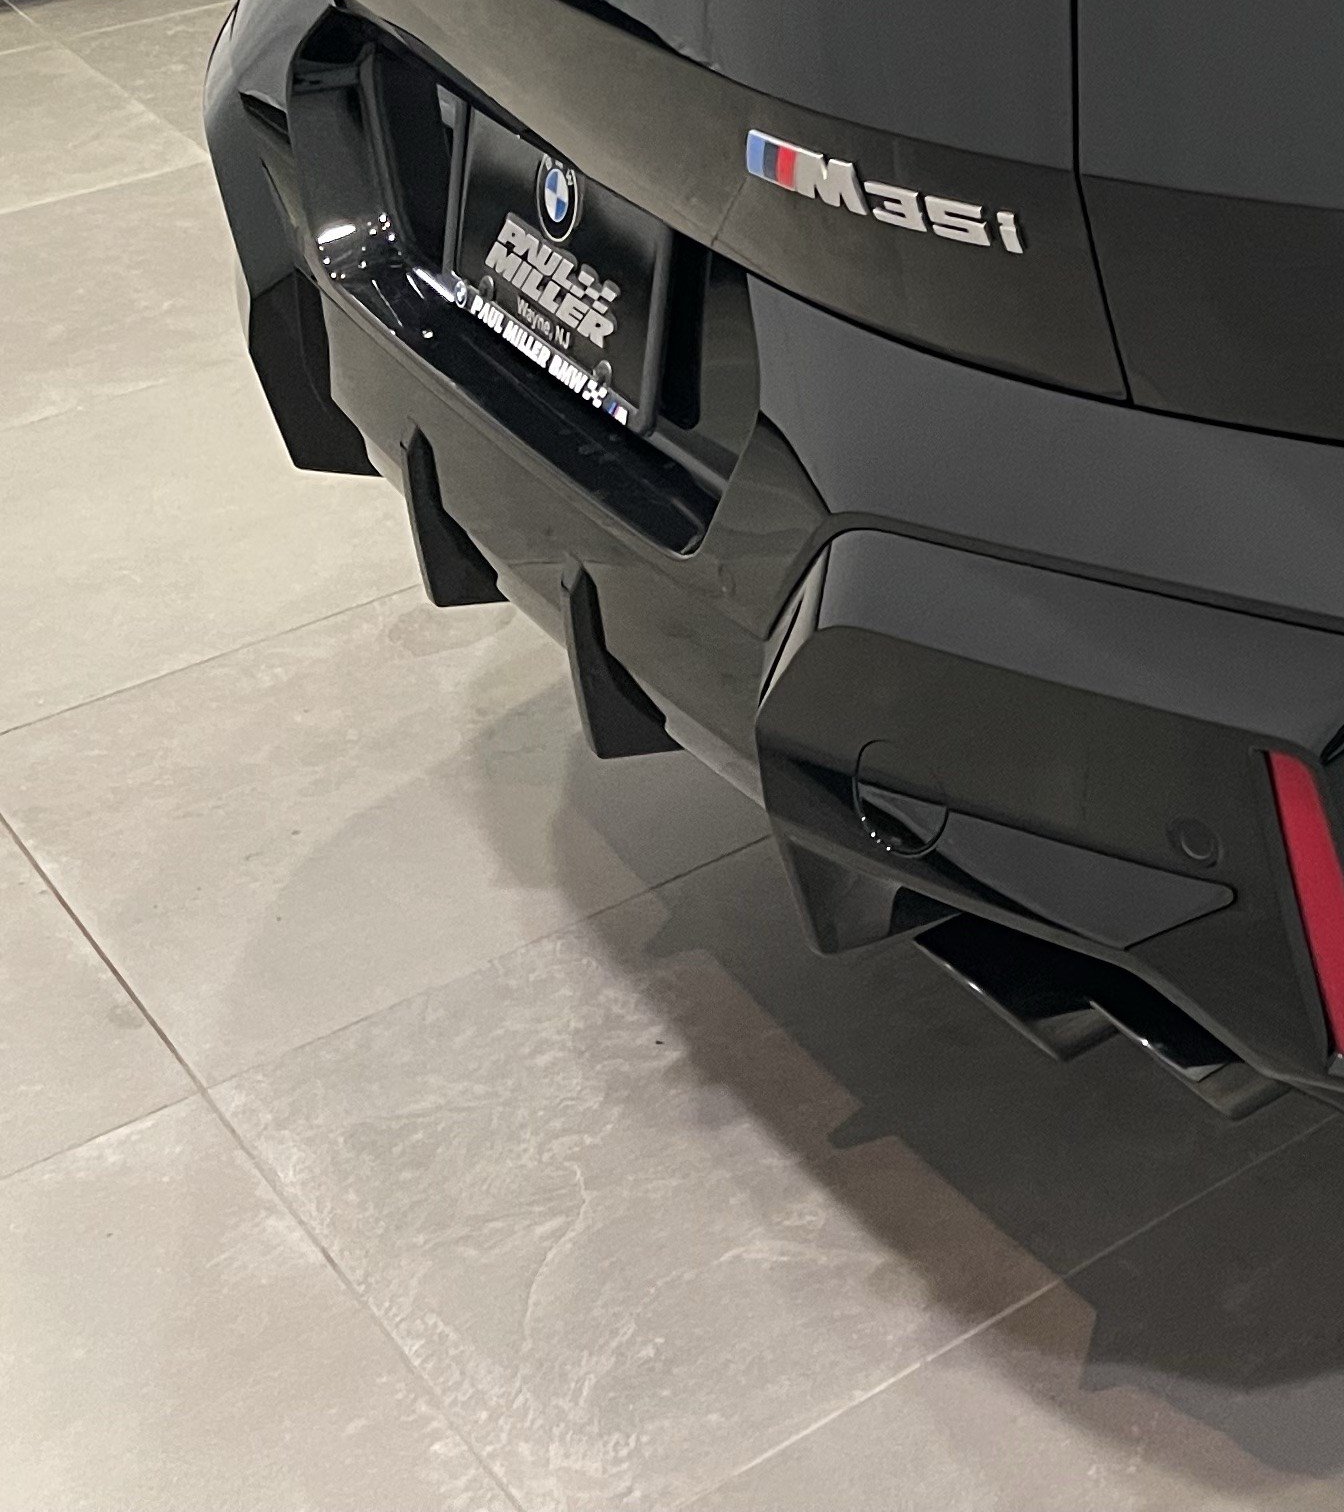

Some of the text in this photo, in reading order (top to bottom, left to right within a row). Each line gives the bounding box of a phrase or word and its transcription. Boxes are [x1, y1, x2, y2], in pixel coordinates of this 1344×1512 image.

[791, 143, 1023, 254] M35i
[485, 241, 614, 348] MILLER
[498, 219, 574, 291] PAUL
[470, 294, 504, 334] PAUL
[502, 320, 550, 368] MILLER
[548, 354, 588, 394] BMW
[516, 295, 570, 350] Wayne, NJ
